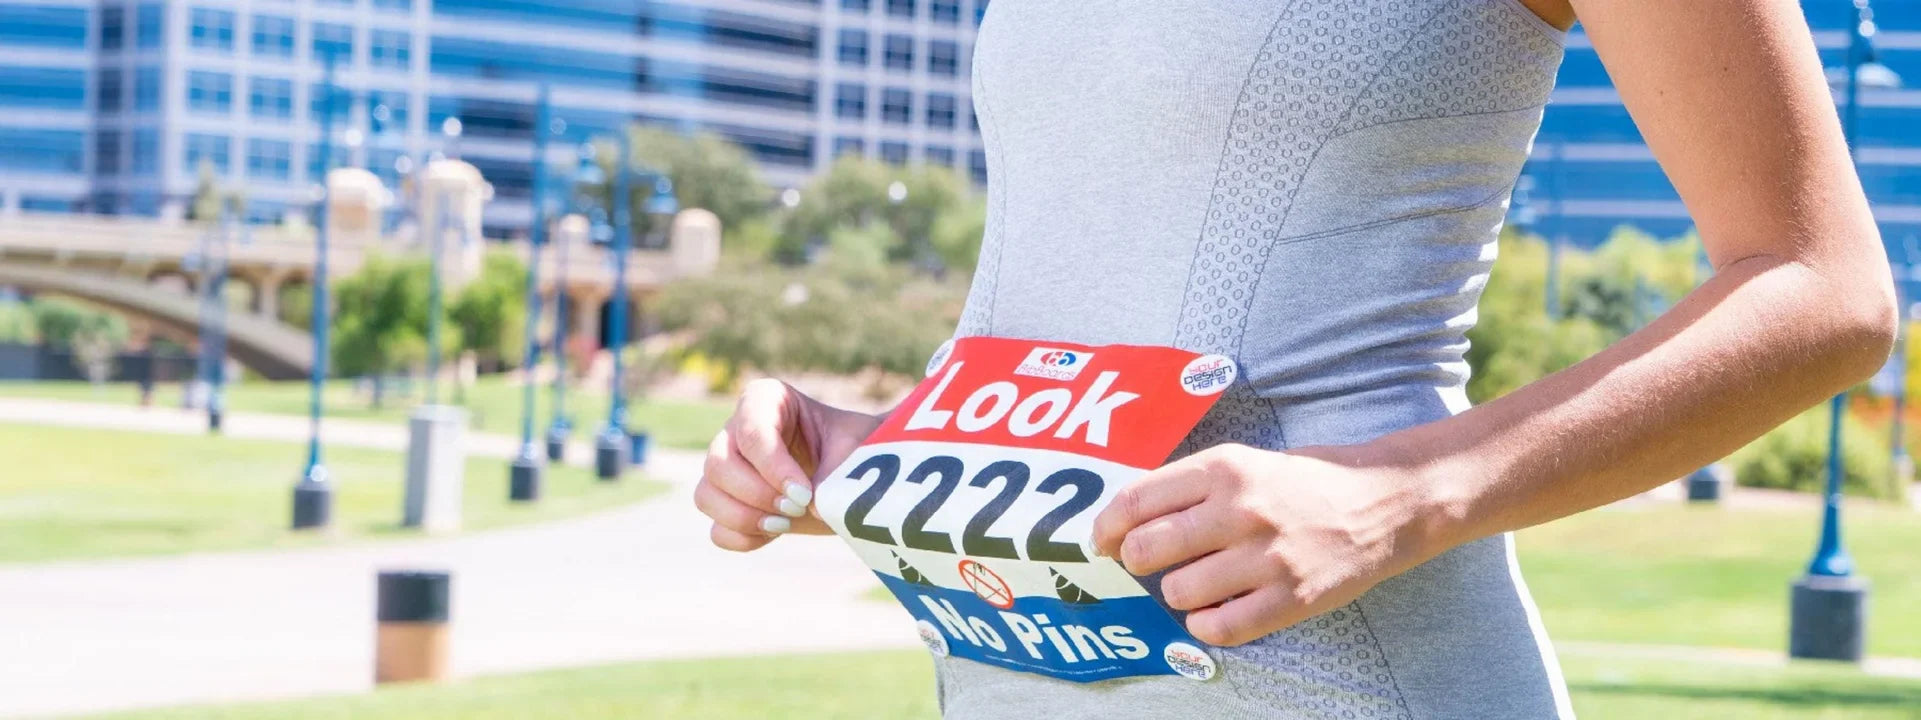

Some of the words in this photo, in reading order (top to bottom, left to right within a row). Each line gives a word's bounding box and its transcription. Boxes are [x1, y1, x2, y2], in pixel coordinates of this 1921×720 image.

[904, 361, 1141, 448] Look
[844, 453, 1105, 563] 2222
[918, 594, 1008, 653] No
[998, 610, 1150, 664] Pins
